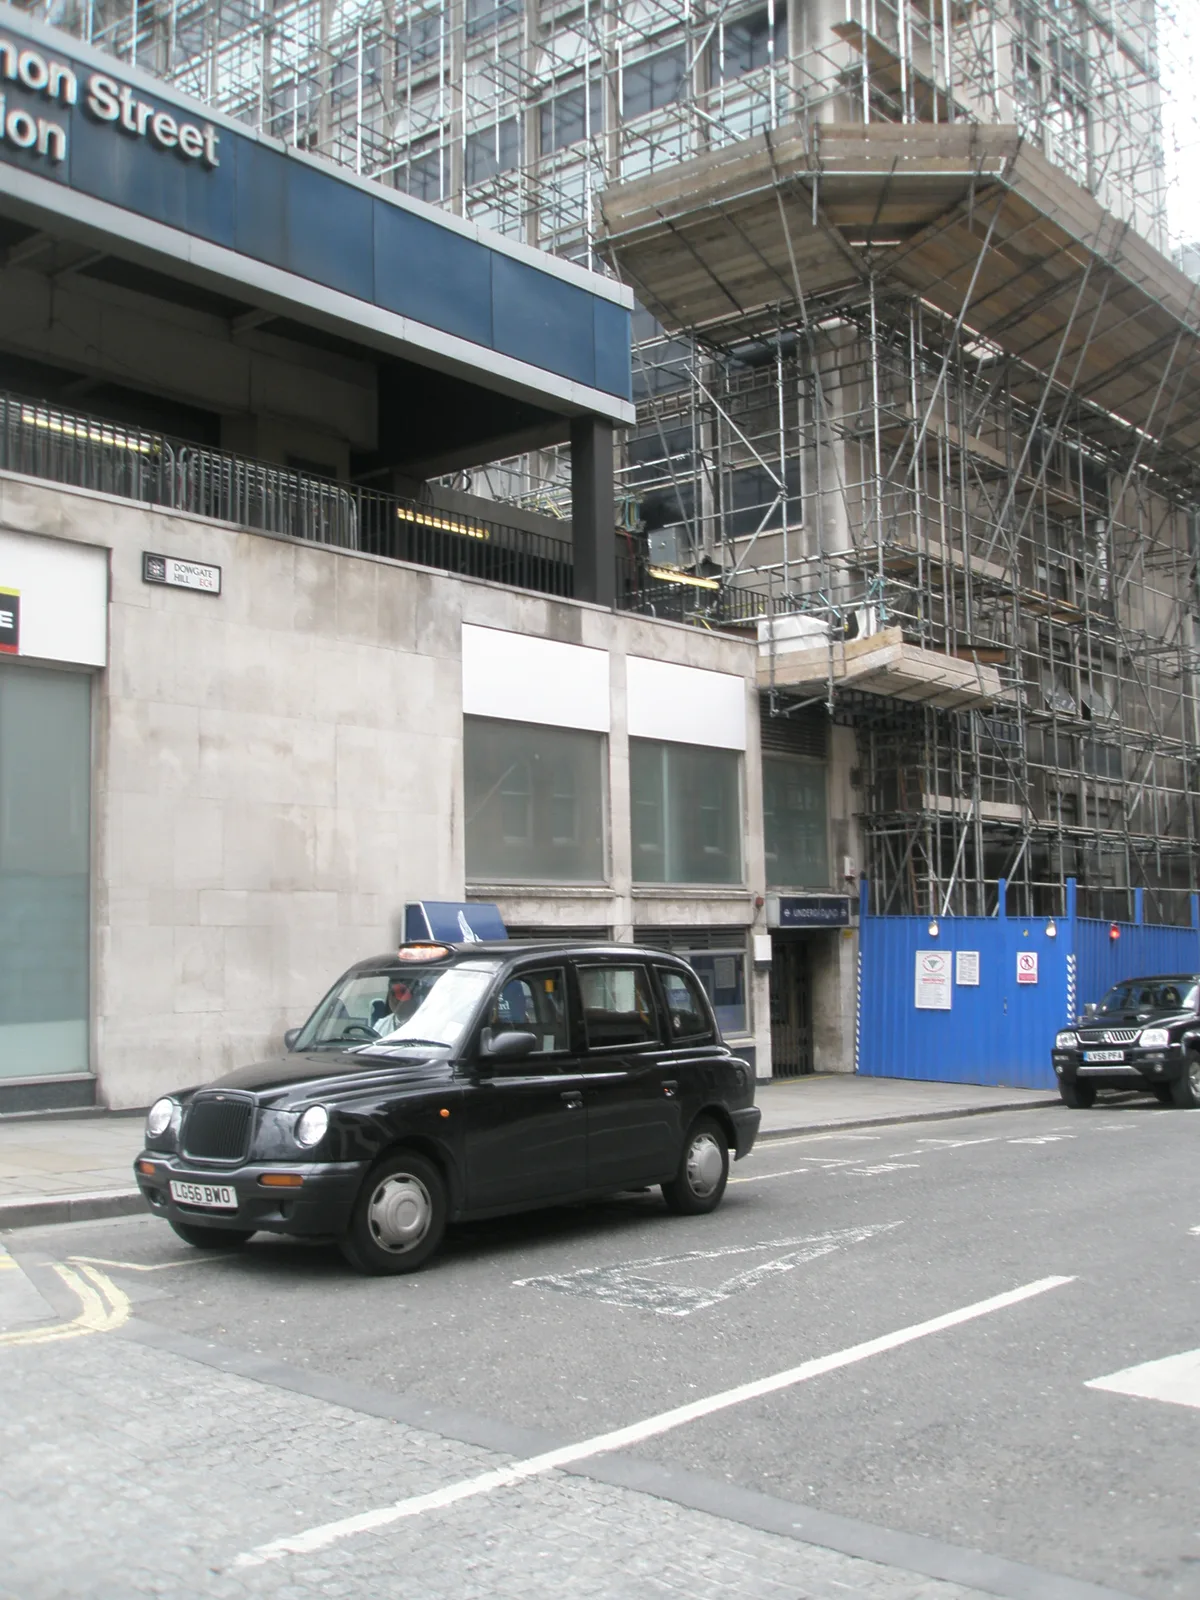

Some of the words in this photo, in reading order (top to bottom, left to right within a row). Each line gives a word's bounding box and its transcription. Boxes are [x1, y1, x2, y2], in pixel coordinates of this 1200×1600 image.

[88, 73, 220, 166] Street
[173, 563, 213, 579] DOWGATE
[173, 573, 191, 585] HILL
[199, 578, 213, 588] EC4
[792, 908, 840, 920] UNDERGROUND
[174, 1182, 203, 1202] LG56
[204, 1187, 231, 1204] BWO
